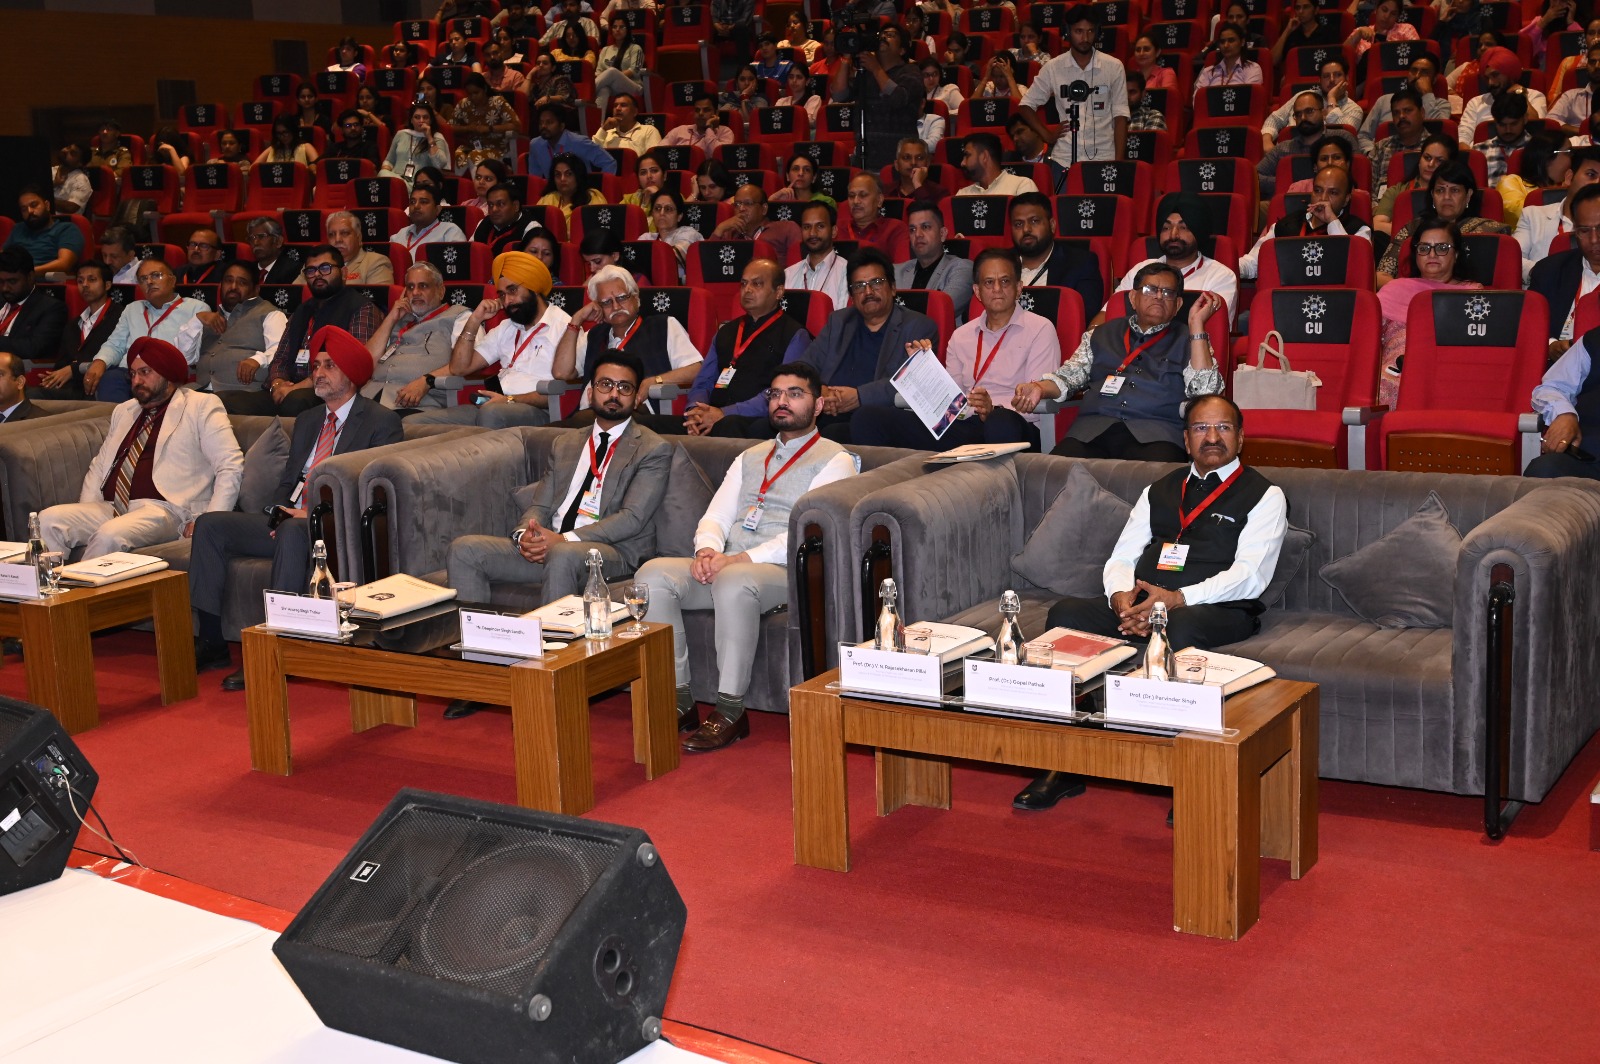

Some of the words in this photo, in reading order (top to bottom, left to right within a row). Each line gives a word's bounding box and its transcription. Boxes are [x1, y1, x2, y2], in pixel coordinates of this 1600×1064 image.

[1104, 183, 1115, 192] CU
[1202, 182, 1214, 190] CU
[974, 220, 986, 229] CU
[1081, 220, 1093, 229] CU
[446, 265, 456, 274] CU
[722, 266, 734, 275] CU
[1306, 265, 1321, 277] CU
[1305, 322, 1323, 335] CU
[1467, 323, 1486, 336] CU
